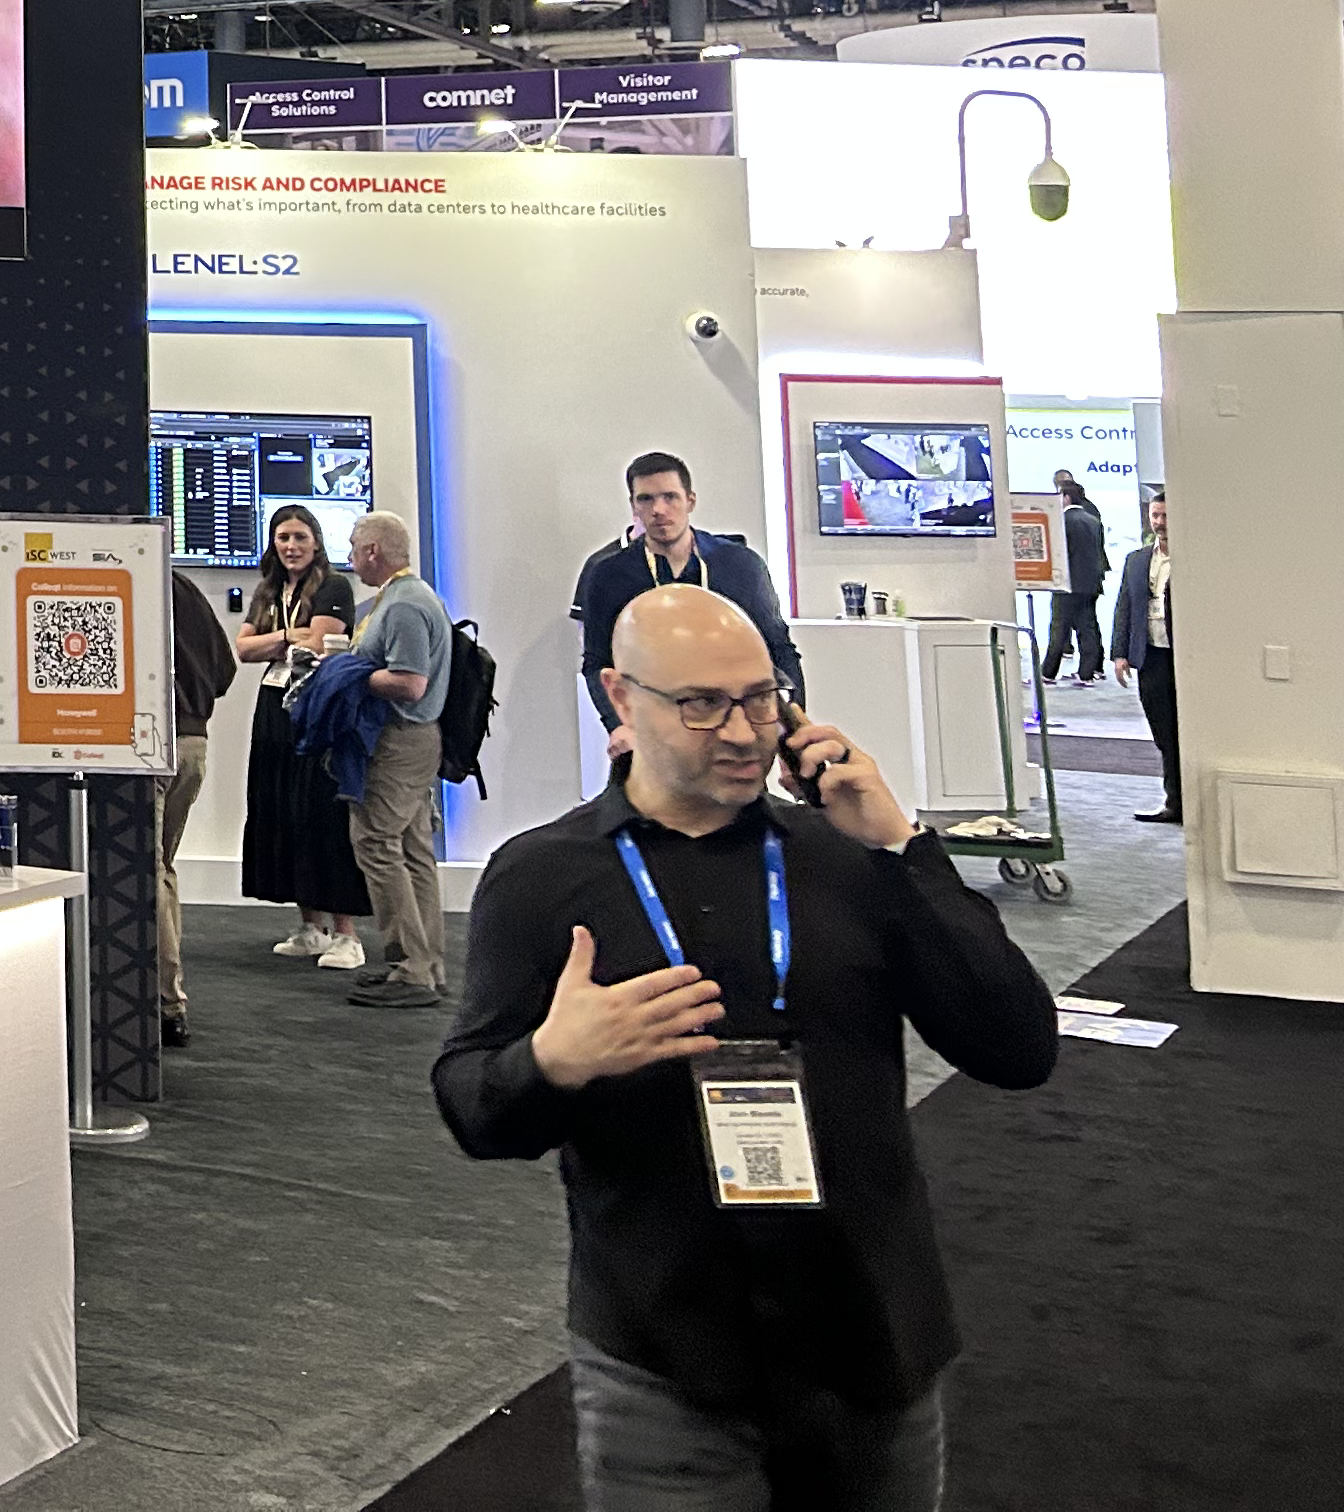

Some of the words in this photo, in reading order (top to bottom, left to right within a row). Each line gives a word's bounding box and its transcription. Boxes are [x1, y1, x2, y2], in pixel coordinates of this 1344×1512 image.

[618, 74, 672, 88] Visitor
[302, 87, 355, 101] Control
[423, 85, 516, 108] comnet
[594, 88, 699, 107] Management
[271, 102, 336, 117] Solutions
[211, 176, 257, 191] RISK
[261, 177, 305, 191] AND
[310, 177, 447, 194] COMPLIANCE
[203, 197, 254, 211] what's
[258, 199, 342, 215] important,
[345, 199, 383, 213] from
[387, 200, 423, 214] data
[427, 202, 487, 215] centers
[490, 201, 507, 215] to
[511, 201, 596, 216] healthcare
[600, 202, 667, 217] facilities
[1006, 424, 1074, 439] Access
[1087, 461, 1138, 476] Adap
[49, 551, 77, 561] WEST
